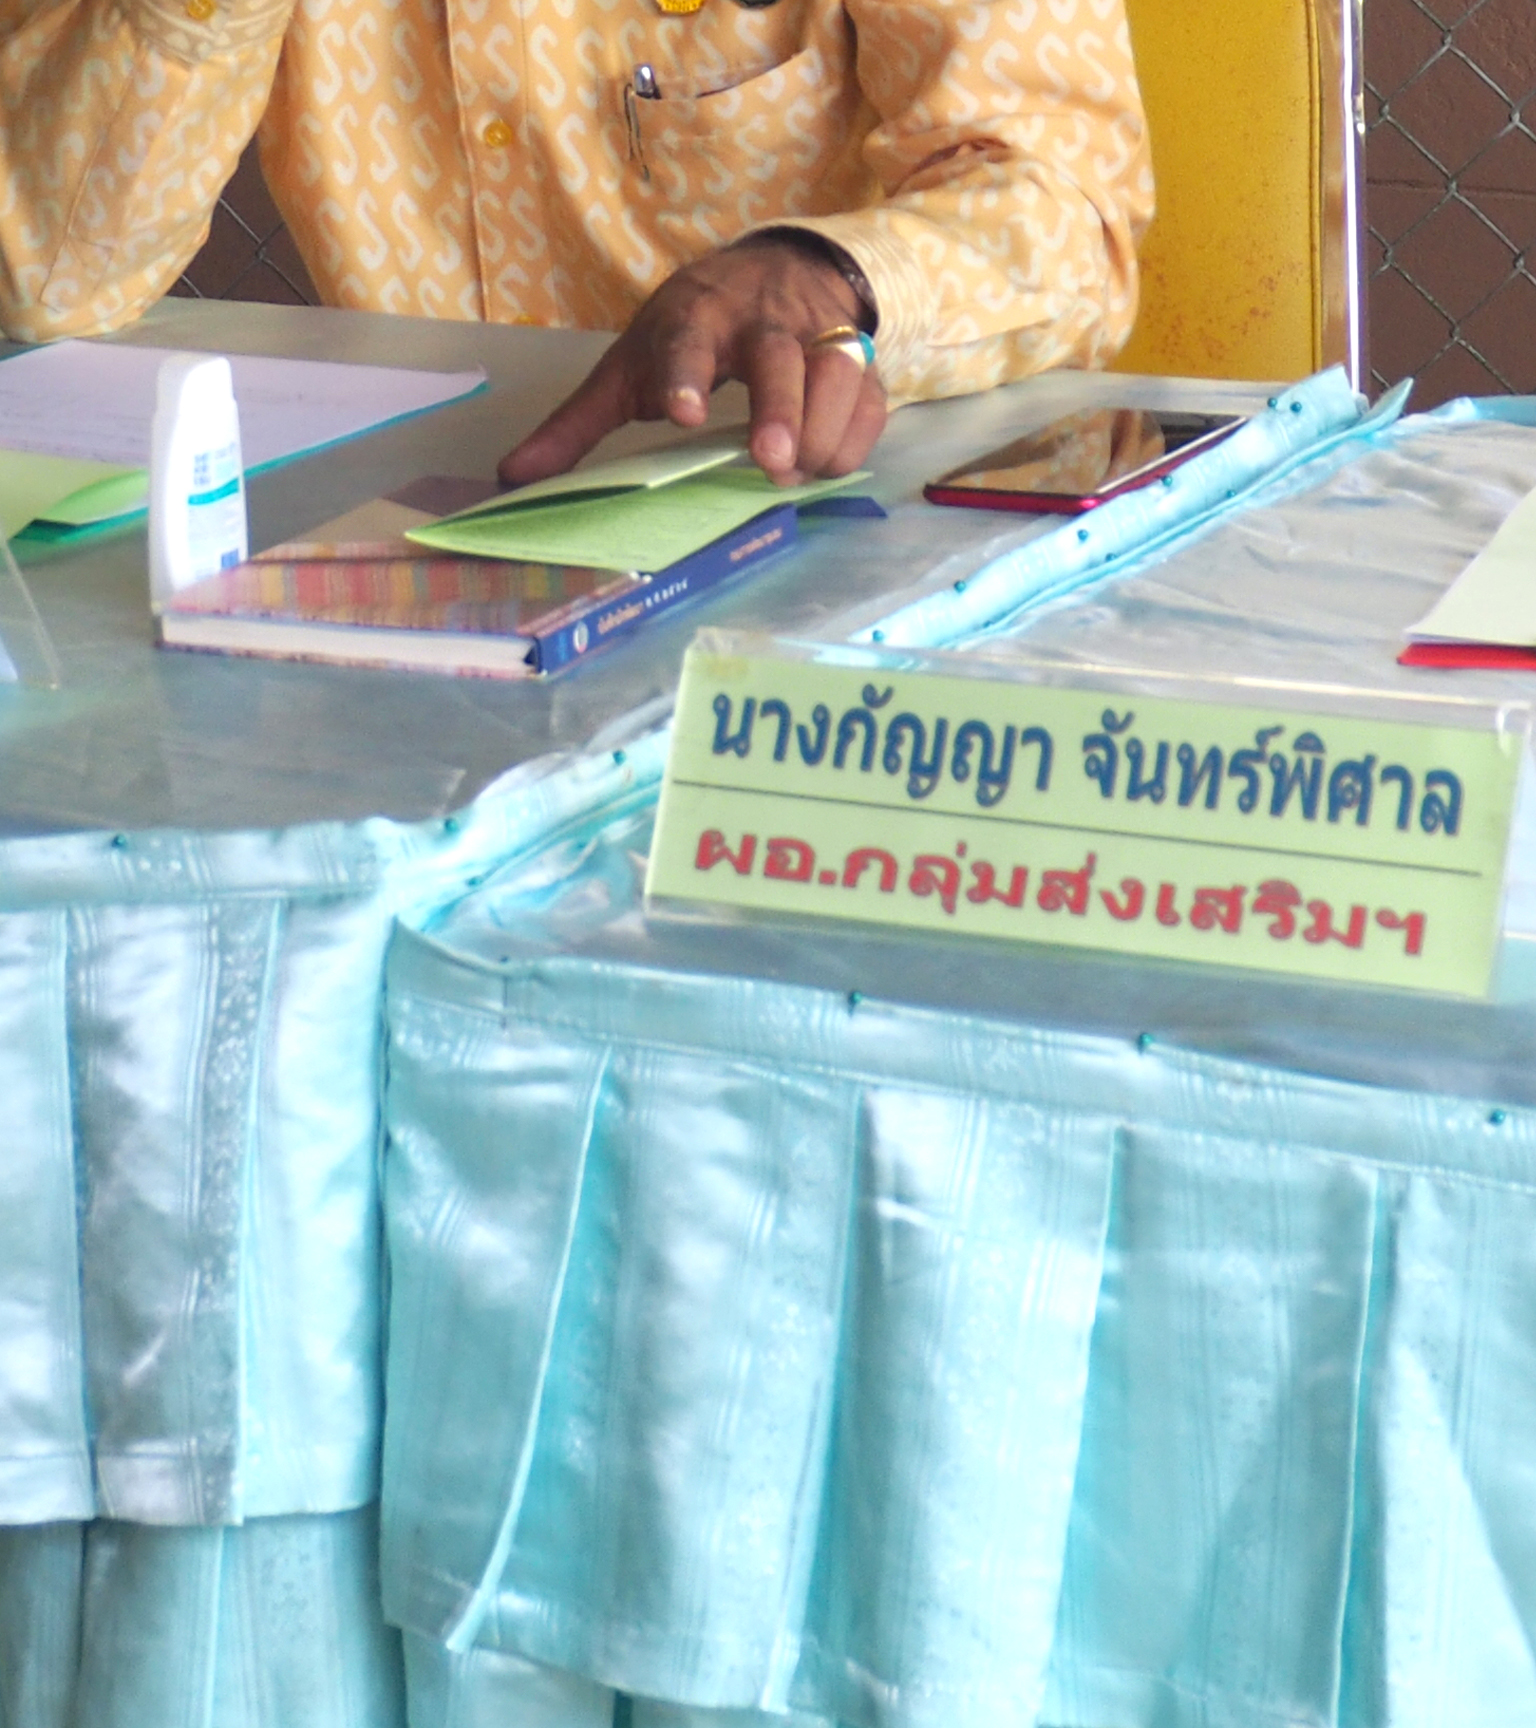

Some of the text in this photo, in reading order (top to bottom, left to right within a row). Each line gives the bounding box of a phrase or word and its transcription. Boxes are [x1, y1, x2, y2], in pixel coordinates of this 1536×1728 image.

[710, 682, 1464, 837] นางกัญญา จันทร์พิศาล
[694, 828, 1426, 957] ผอ.กลุ่มส่งเสริมฯ
